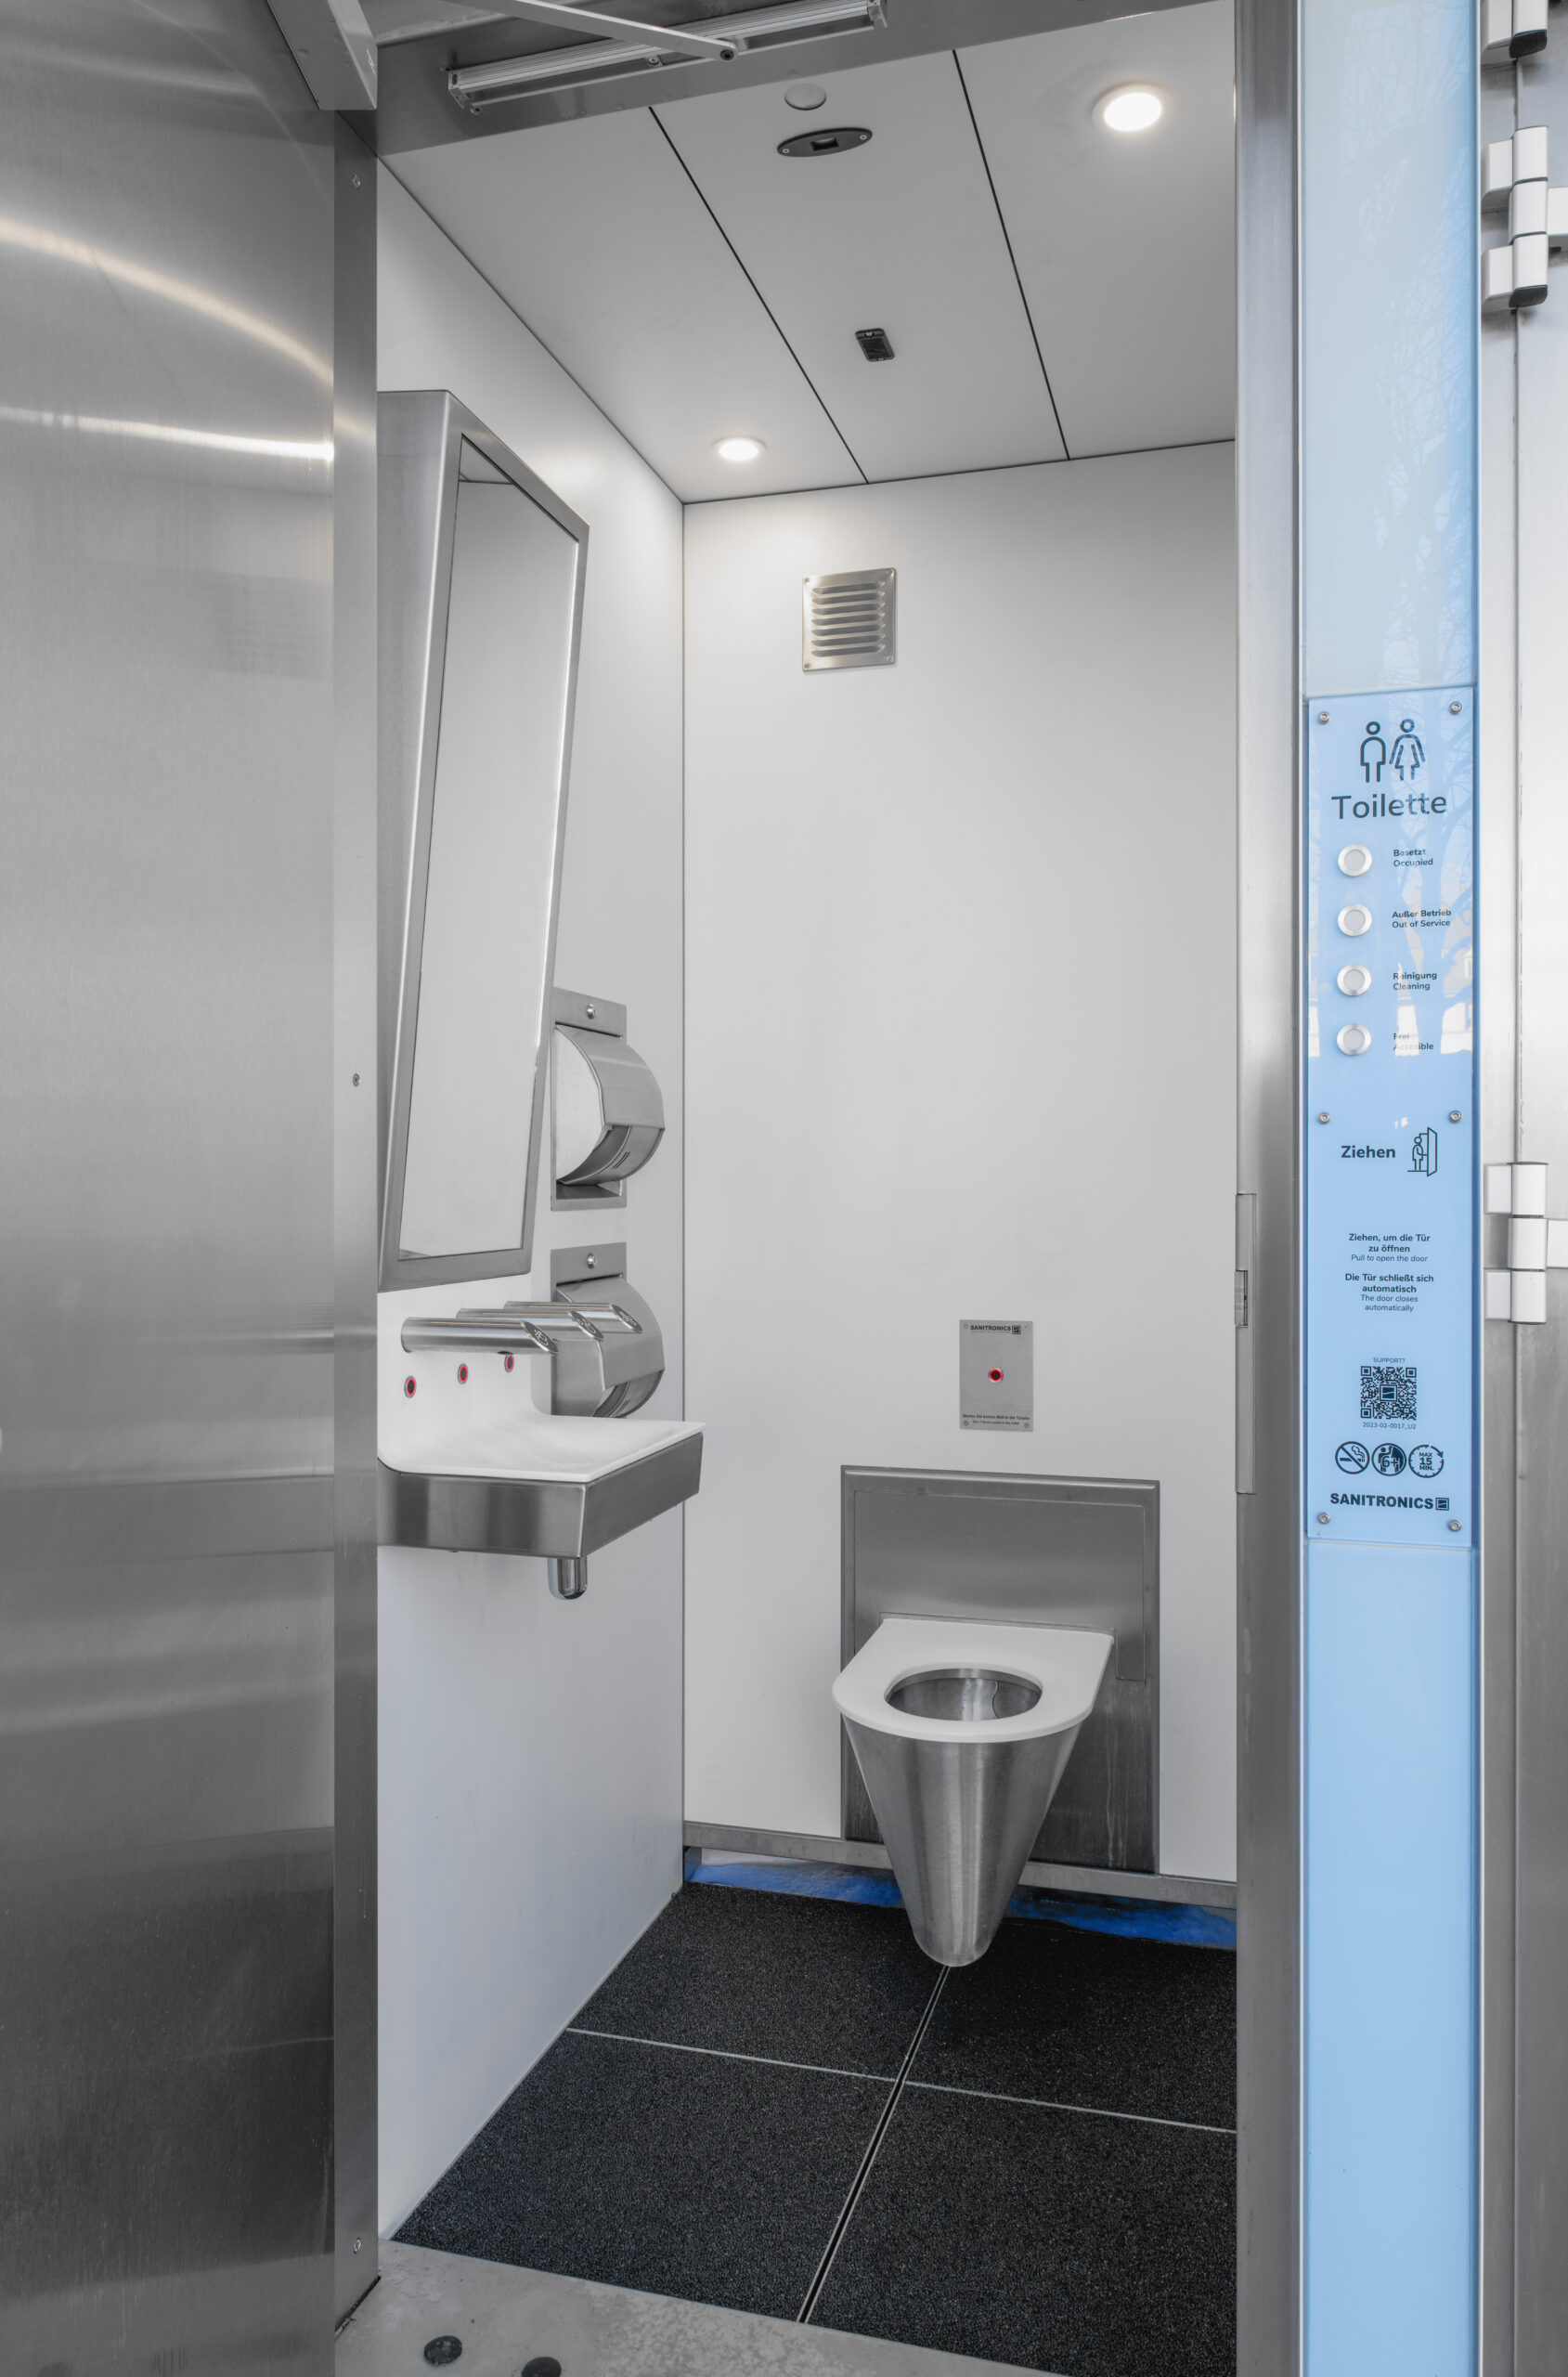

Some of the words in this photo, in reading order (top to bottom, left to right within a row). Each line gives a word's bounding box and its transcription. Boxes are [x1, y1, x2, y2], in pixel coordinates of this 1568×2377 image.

[1331, 794, 1446, 819] Toilette
[1393, 858, 1433, 867] Occupied
[1420, 909, 1452, 917] Betrieb
[1420, 919, 1451, 928] Service
[1393, 971, 1437, 981] Reinigung
[1393, 982, 1431, 991] Cleaning
[1341, 1145, 1395, 1158] Ziehen
[1349, 1233, 1380, 1241] Ziehen,
[1399, 1233, 1413, 1241] die
[1415, 1233, 1431, 1241] Tür
[1381, 1244, 1410, 1253] öffnen
[1351, 1253, 1365, 1262] Pull
[1345, 1273, 1360, 1281] Die
[1362, 1273, 1377, 1281] Tür
[1379, 1274, 1414, 1282] schließt
[1362, 1285, 1417, 1293] automatisch
[1365, 1305, 1415, 1313] automatically
[1419, 1457, 1432, 1465] 15
[1329, 1492, 1434, 1510] SANITRONICS
